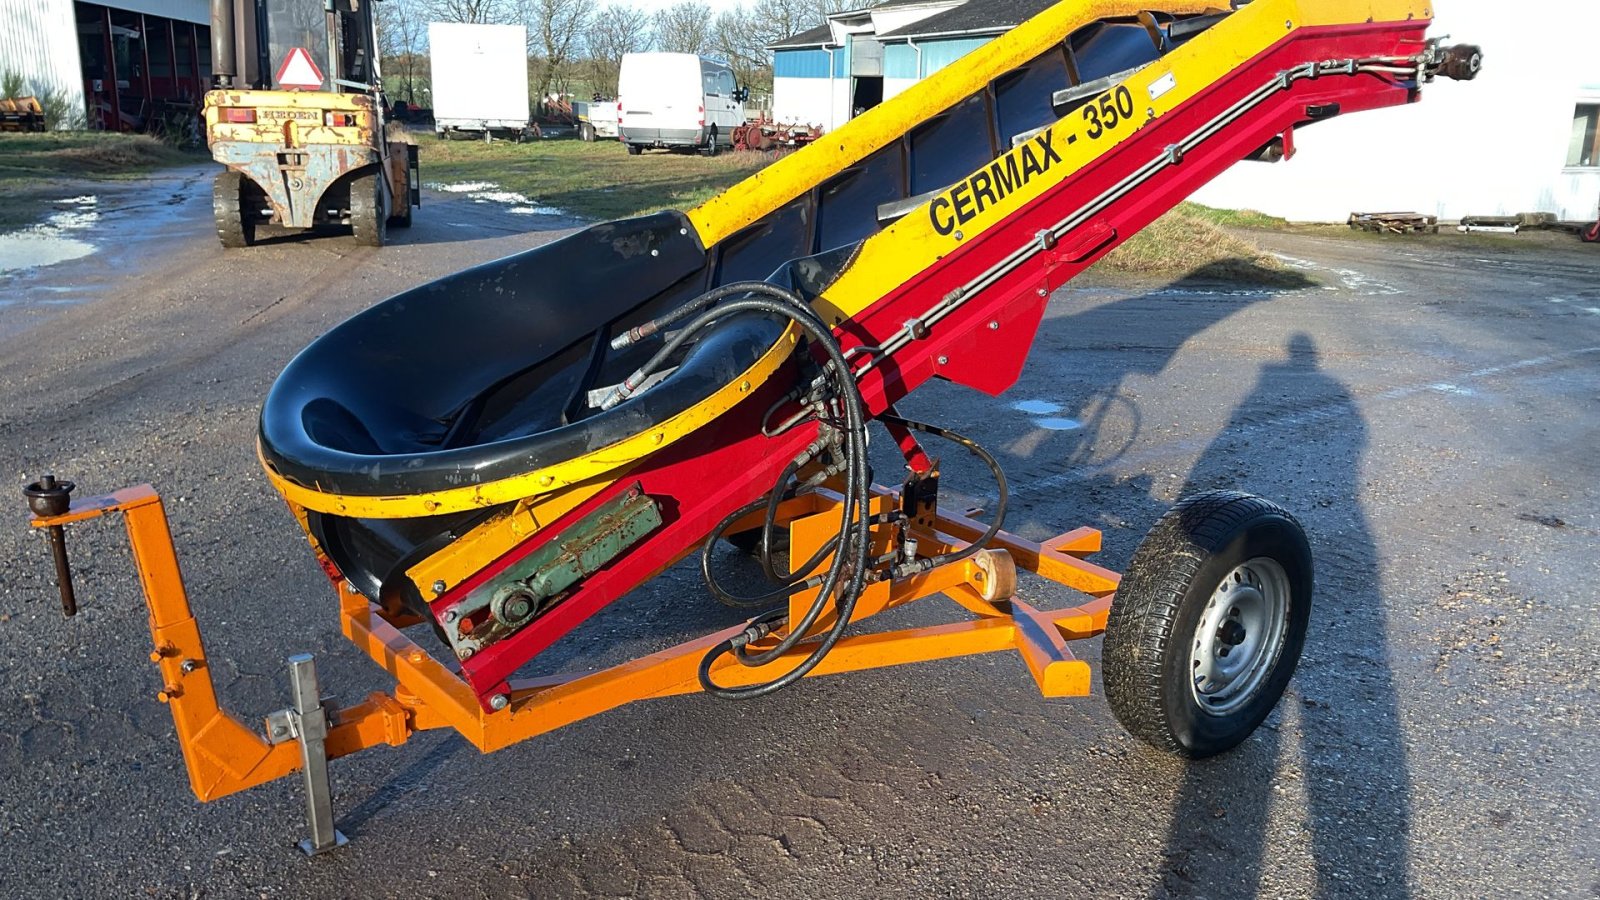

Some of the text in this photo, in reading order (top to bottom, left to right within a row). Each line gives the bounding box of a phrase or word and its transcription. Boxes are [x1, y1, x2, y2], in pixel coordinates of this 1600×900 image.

[929, 85, 1134, 236] CERMAX - 350
